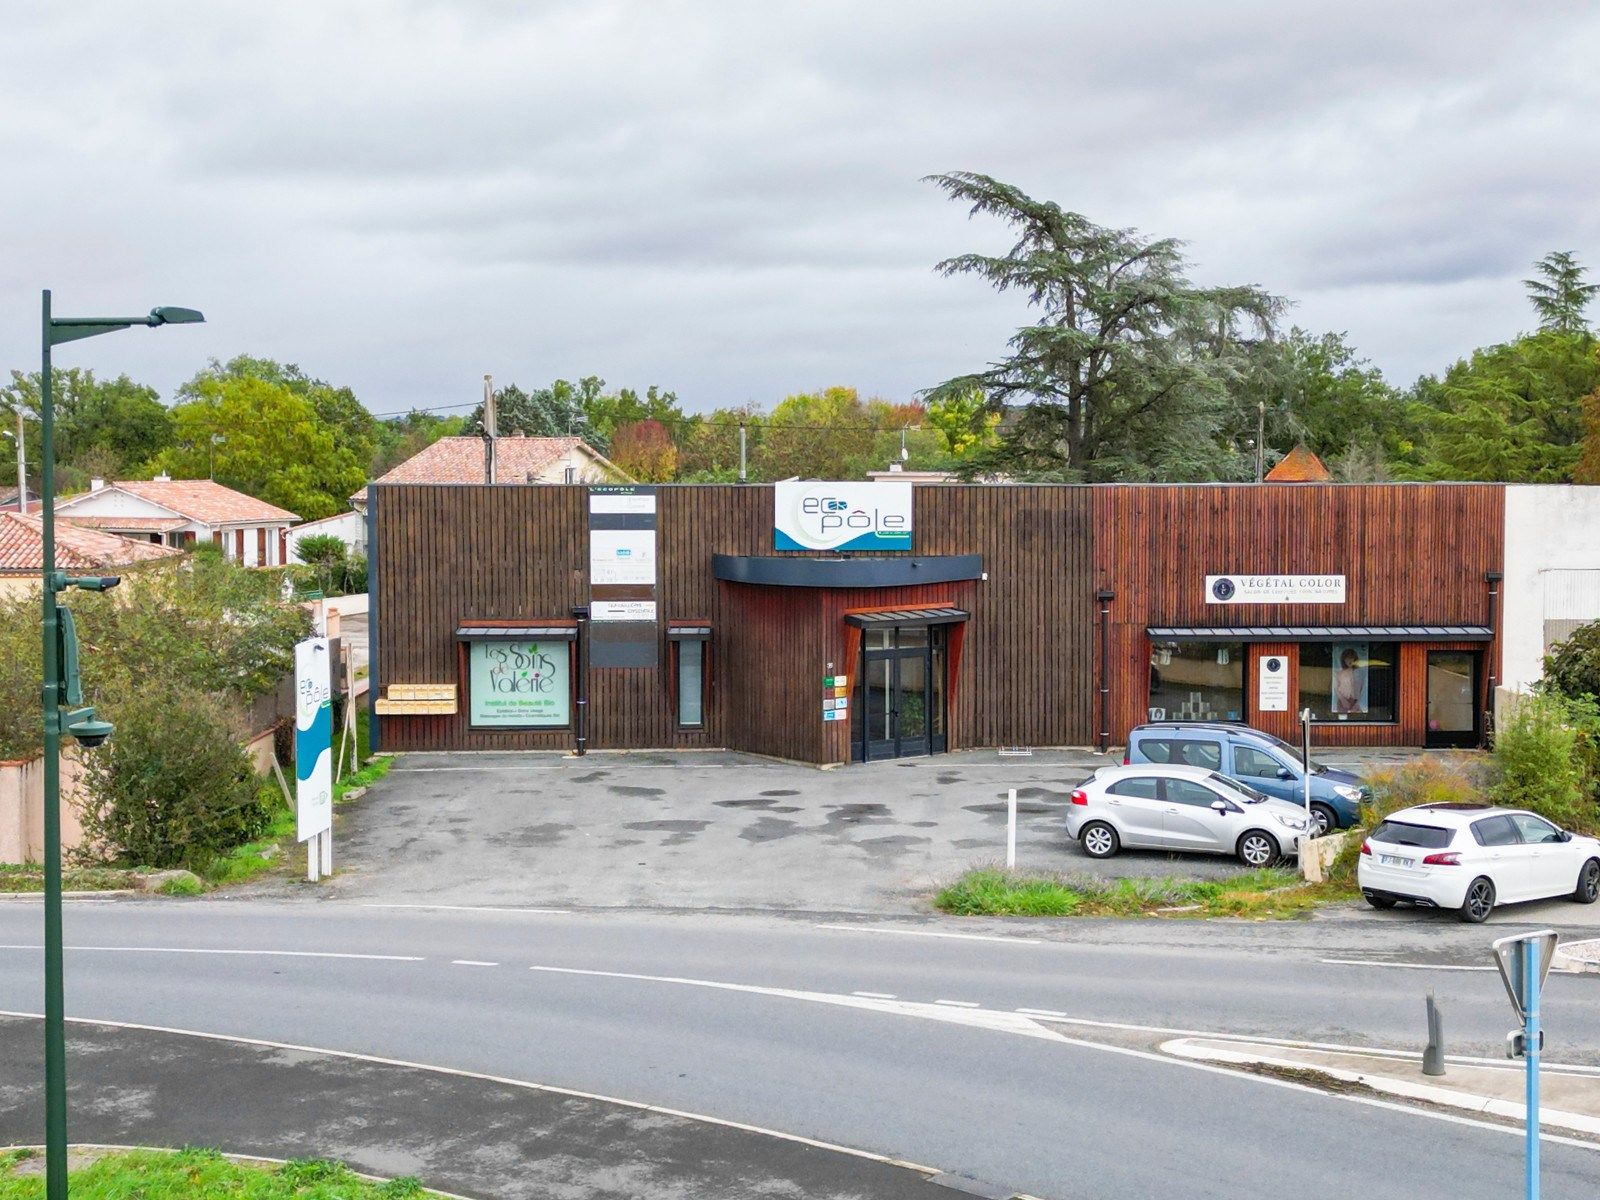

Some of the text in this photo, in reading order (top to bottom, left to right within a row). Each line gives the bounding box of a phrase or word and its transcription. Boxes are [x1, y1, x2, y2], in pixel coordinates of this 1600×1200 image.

[821, 508, 905, 534] pôle
[1240, 577, 1342, 588] VÉGÉTAL COLOR
[509, 643, 556, 679] Soins
[490, 671, 555, 694] Valérie
